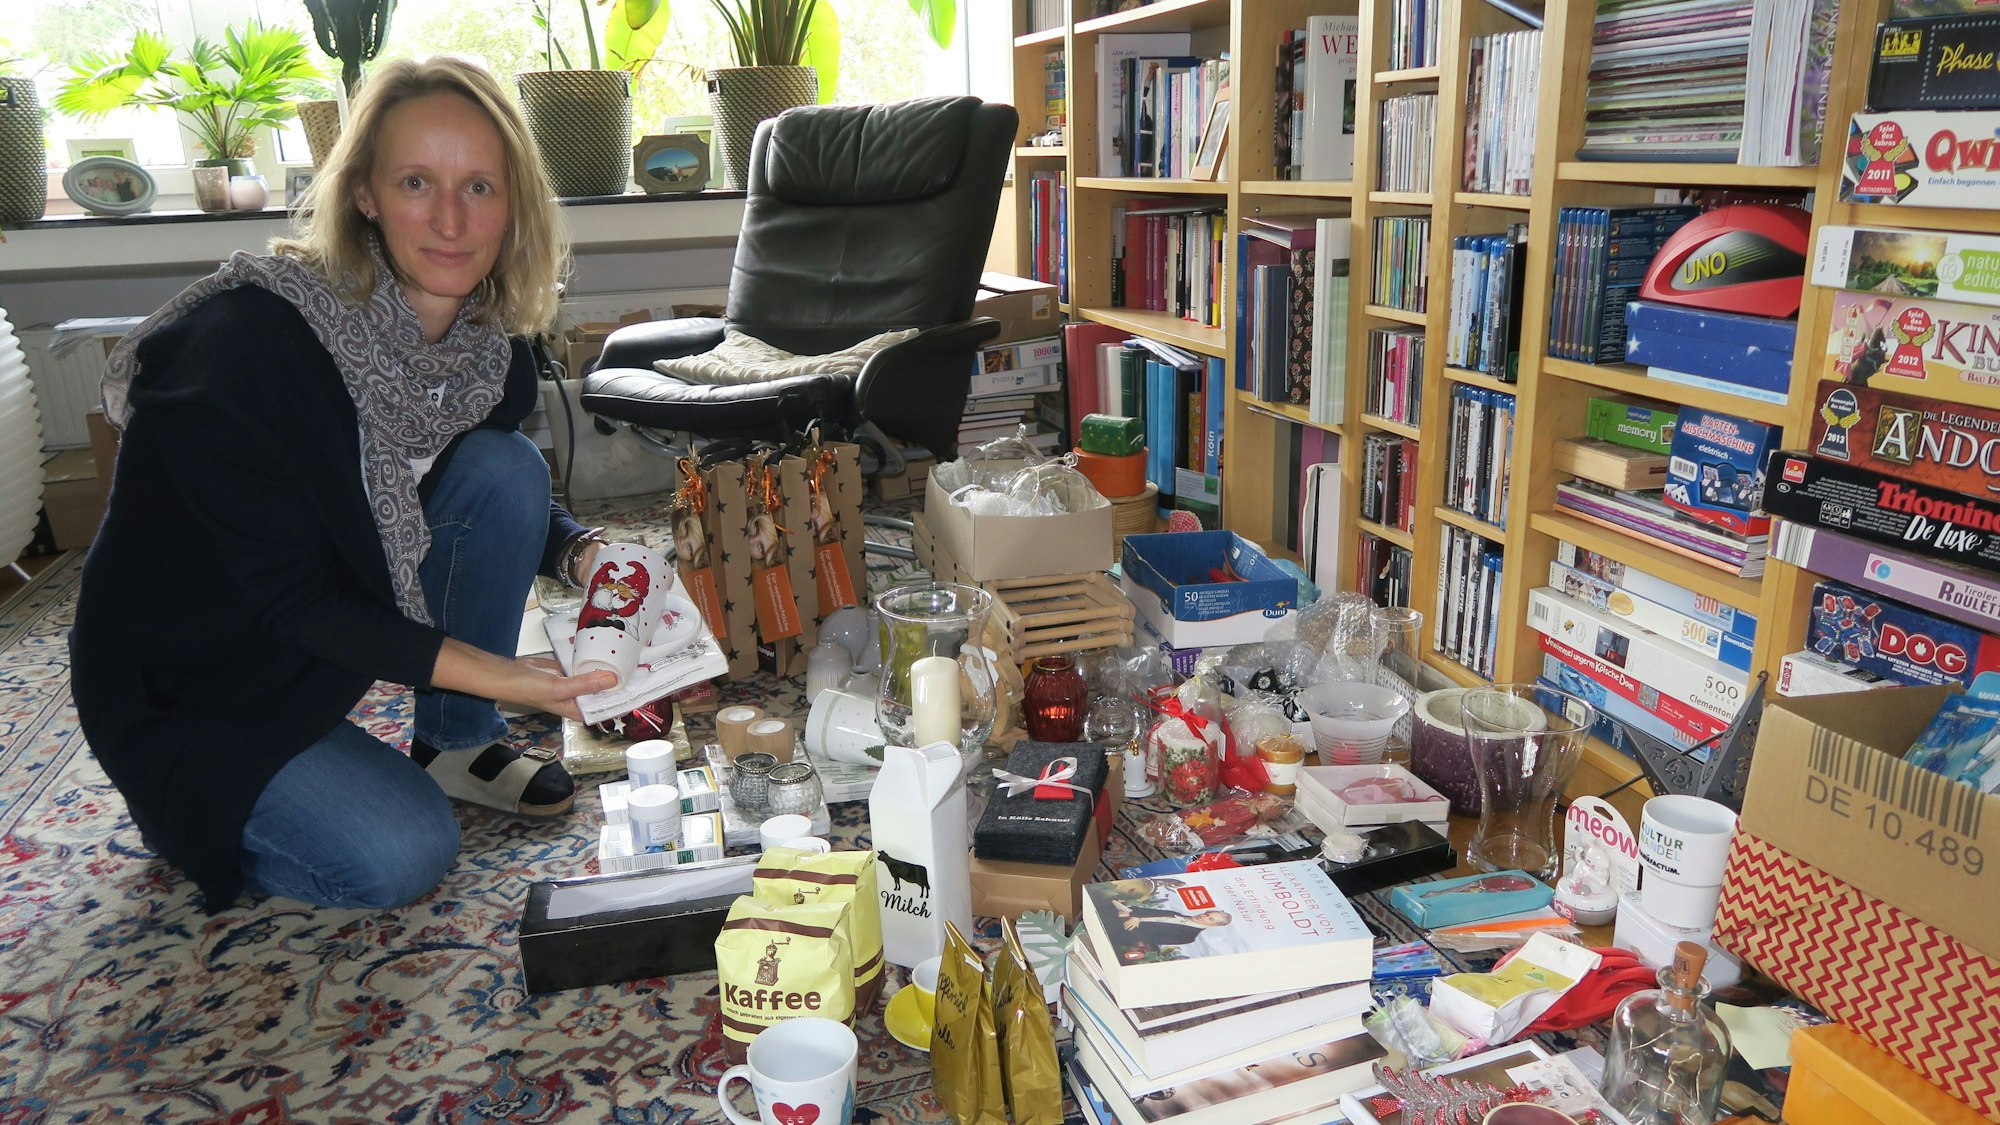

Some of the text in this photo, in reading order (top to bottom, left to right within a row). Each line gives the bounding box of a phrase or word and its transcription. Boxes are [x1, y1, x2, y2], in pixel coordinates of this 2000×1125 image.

[1936, 42, 1994, 77] Phase
[1879, 124, 1895, 134] Spiel
[1881, 132, 1893, 140] des
[1874, 138, 1896, 147] Jahres
[1867, 169, 1891, 181] 2011
[1928, 177, 1996, 187] Einfach begonnen
[1683, 251, 1727, 284] UNO
[1907, 310, 1924, 319] Spiel
[1903, 323, 1926, 333] Jahres
[1033, 346, 1051, 358] 1000
[1897, 354, 1919, 366] 2012
[1617, 421, 1657, 442] memory
[1701, 415, 1739, 436] KARTEN-
[1923, 411, 2000, 434] DIE LEGENDE
[1206, 429, 1215, 458] Köln
[1681, 421, 1755, 454] MISCHMASCHINE
[1827, 432, 1846, 444] 2013
[1698, 443, 1729, 461] elektrisch
[1903, 514, 1936, 541] De
[1184, 591, 1198, 602] 50
[1458, 574, 1467, 614] TRAFFIC
[1695, 593, 1719, 615] 500
[1964, 585, 1998, 602] Tiroler
[1265, 607, 1286, 617] Duni
[1682, 620, 1706, 643] 500
[1878, 623, 1967, 674] DOG
[1545, 636, 1635, 692] Jewimmel ungerm Kölsche Dom
[1876, 652, 1887, 660] DEN
[1887, 656, 1910, 668] LETZTEN
[1704, 675, 1738, 700] 500
[1704, 688, 1736, 707] PUZZLE
[1689, 694, 1735, 720] Clementoni
[1009, 813, 1033, 821] Kölle
[1805, 775, 1984, 876] DE 10.489
[1568, 803, 1639, 860] meow
[880, 890, 932, 919] Milch
[1224, 885, 1254, 924] der Natur
[1234, 877, 1276, 931] die Erfindung
[1256, 867, 1319, 938] HUMBOLDT
[1277, 865, 1336, 935] ALEXANDER VON
[1301, 864, 1360, 933] ANDREA WULF
[724, 982, 822, 1011] Kaffee
[740, 1011, 763, 1020] gebrannt
